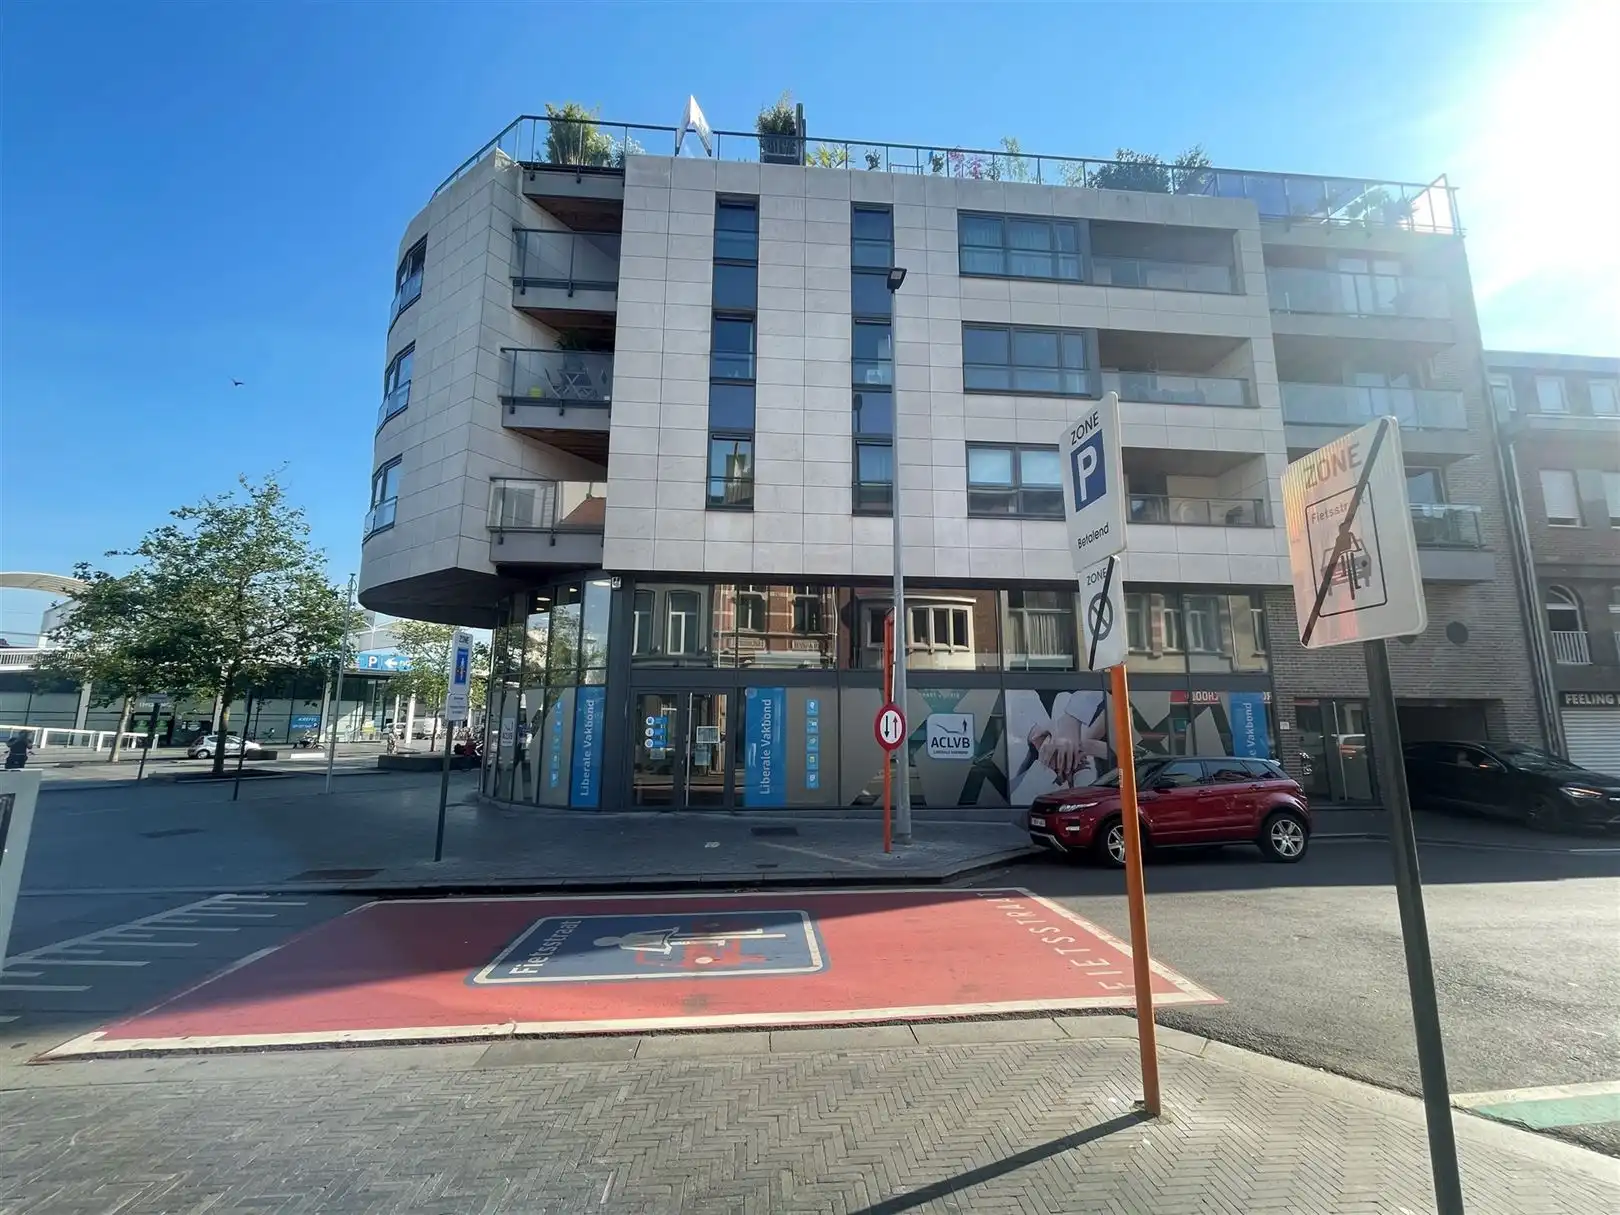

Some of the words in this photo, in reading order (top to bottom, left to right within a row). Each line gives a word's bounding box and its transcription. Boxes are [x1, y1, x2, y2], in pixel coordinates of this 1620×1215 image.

[1070, 410, 1100, 446] ZONE
[1076, 445, 1098, 502] P
[1303, 442, 1363, 491] ZONE
[1310, 493, 1370, 525] Fietsstrt
[1077, 521, 1111, 550] Betalend
[1086, 567, 1108, 586] ZONE
[368, 655, 378, 667] P
[1565, 693, 1615, 705] FEELING
[582, 699, 595, 748] Vakbond
[760, 698, 772, 747] Vakbond
[930, 736, 971, 749] ACLVB
[1242, 702, 1257, 748] Vakbond
[580, 750, 592, 796] Liberale
[759, 749, 772, 795] Liberale
[508, 920, 582, 975] Fietsstraat
[976, 892, 1135, 990] FIETSSTRAAT
